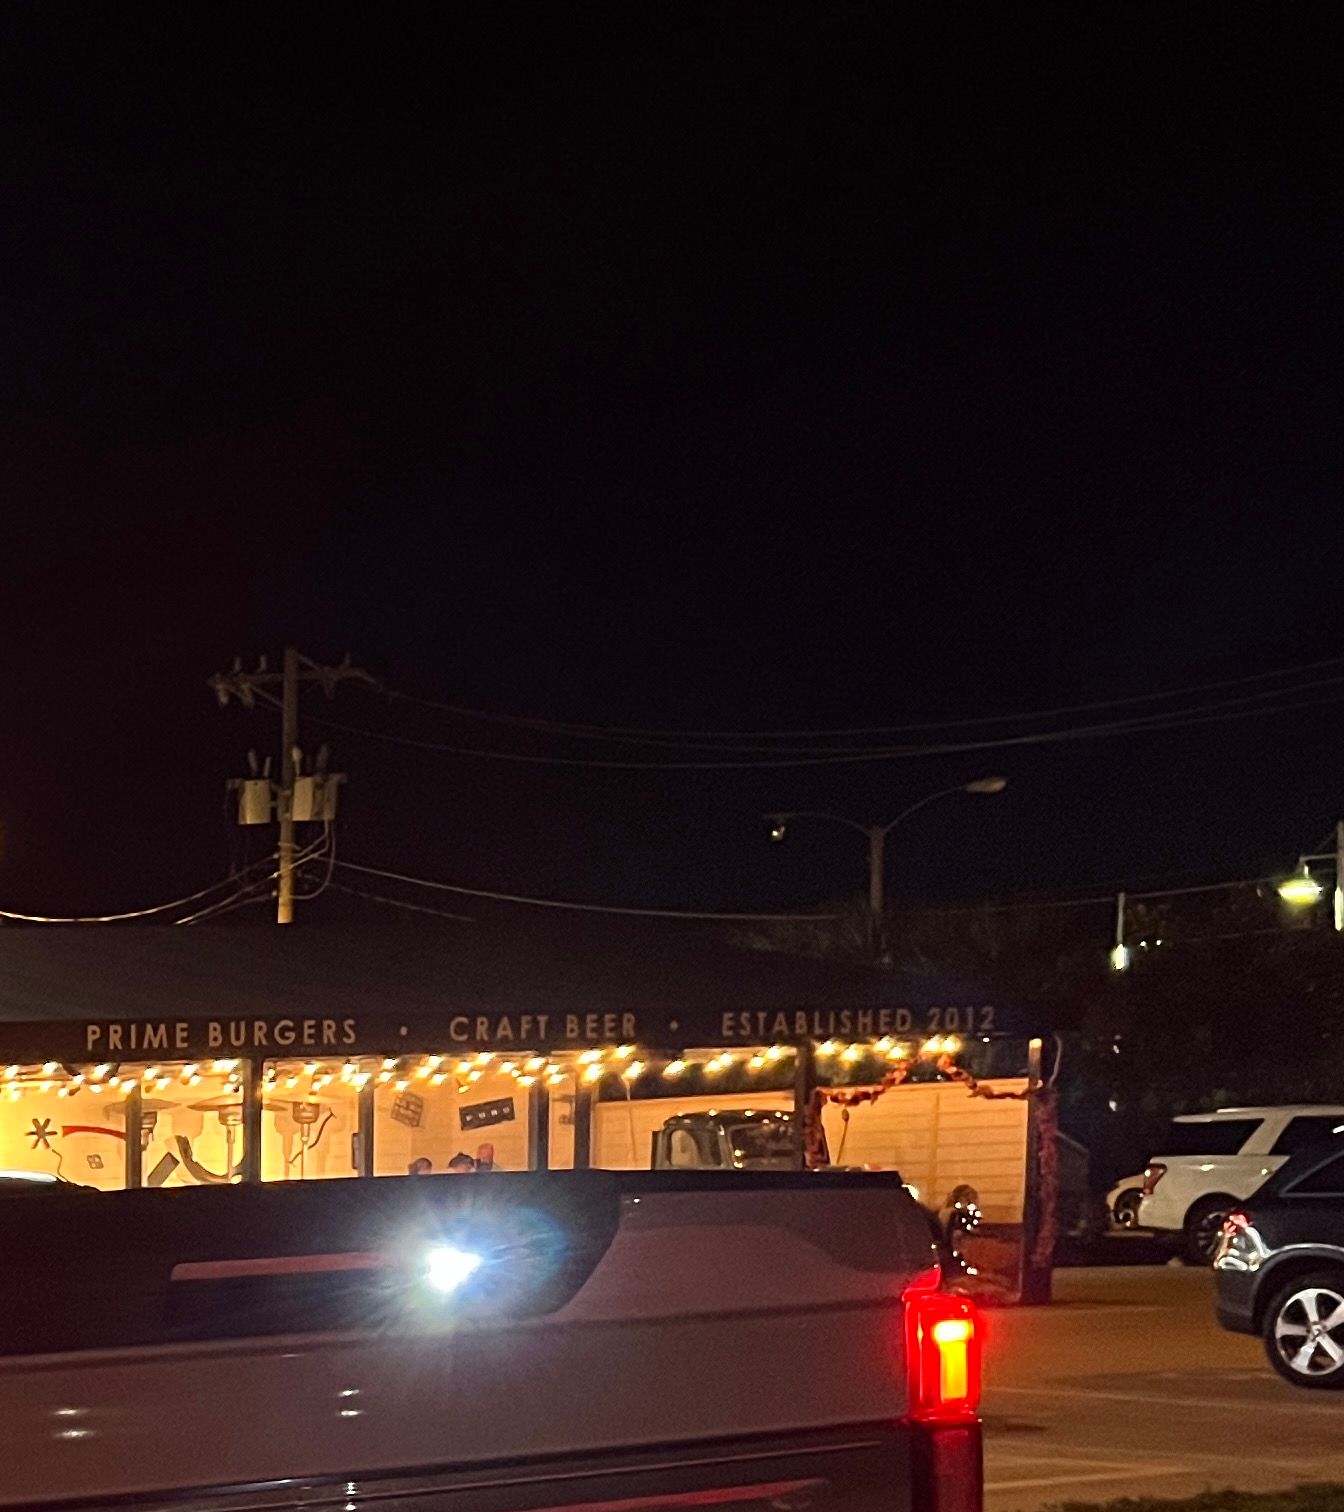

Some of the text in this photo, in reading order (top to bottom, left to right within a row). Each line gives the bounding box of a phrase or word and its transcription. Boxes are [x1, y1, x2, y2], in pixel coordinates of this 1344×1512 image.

[85, 1005, 994, 1051] PRIME BURGERS CRAFT BEER ESTABLISHED 2012
